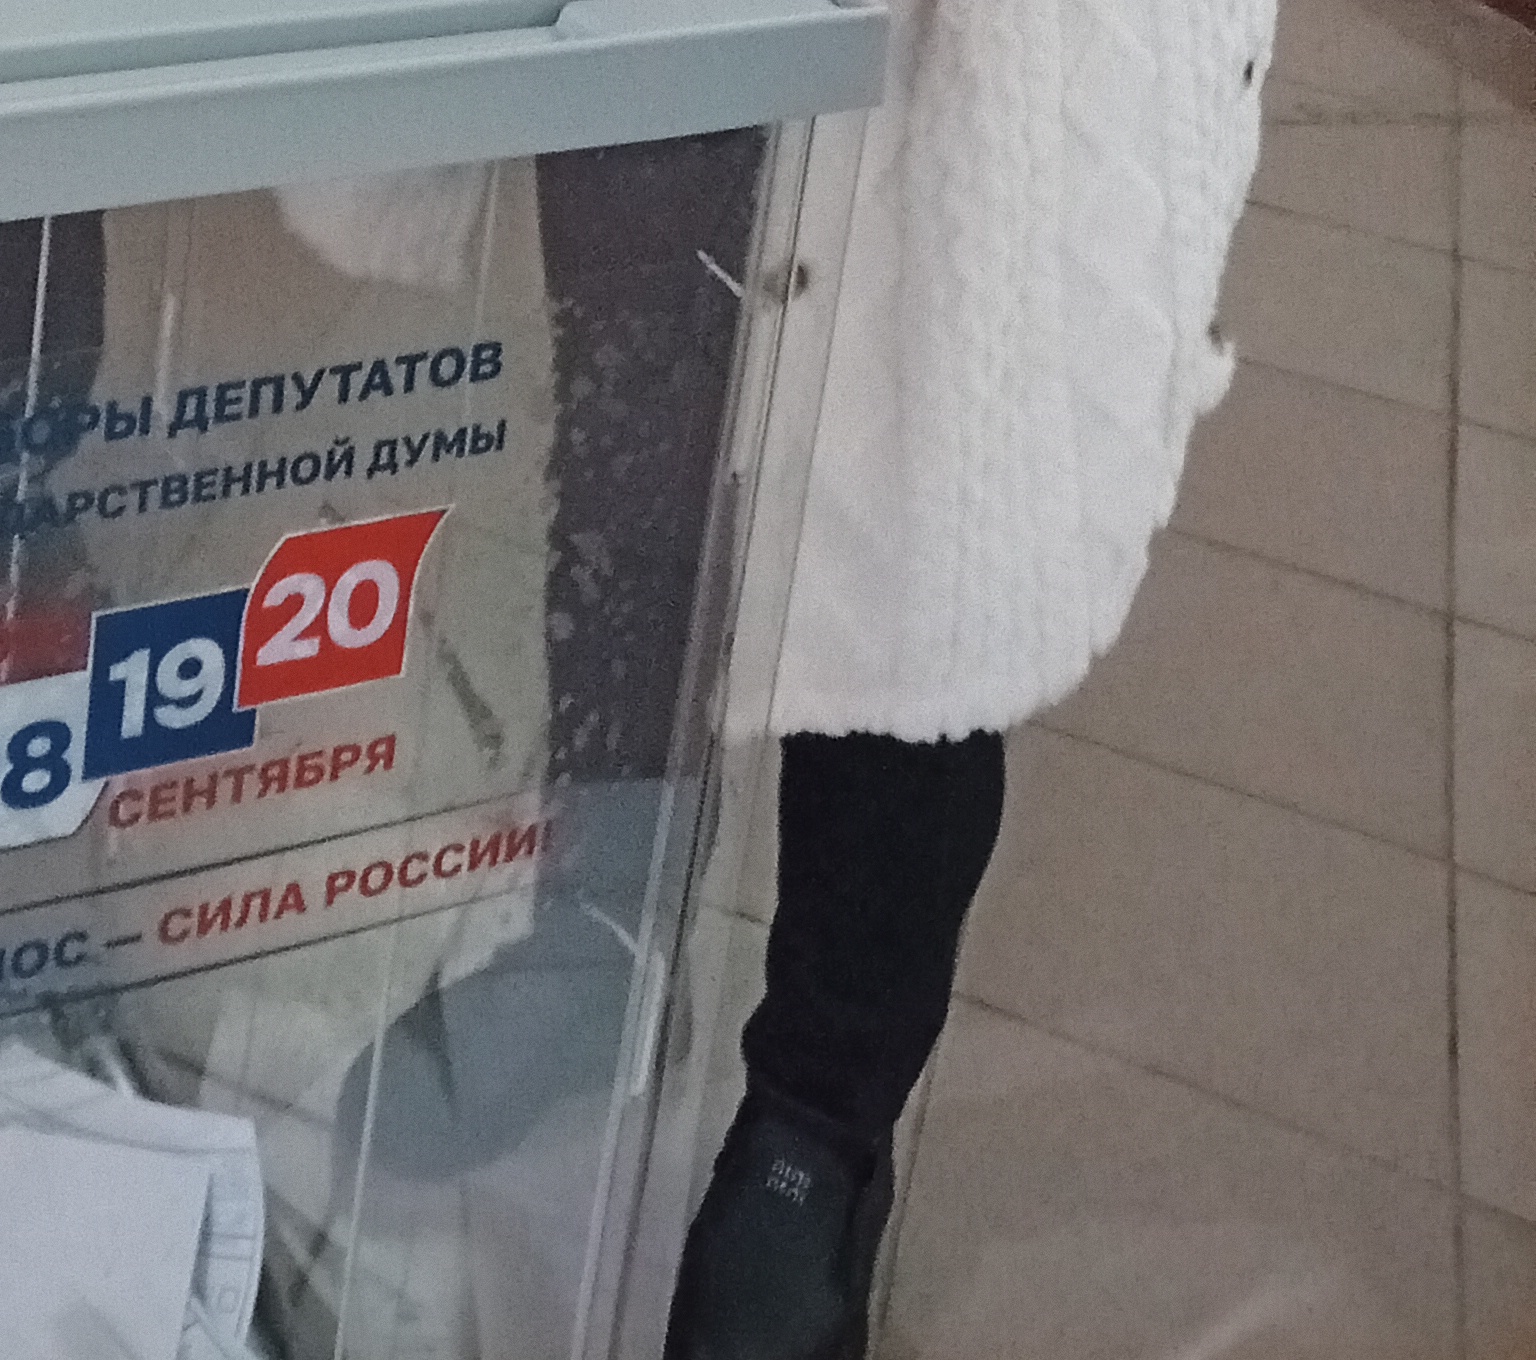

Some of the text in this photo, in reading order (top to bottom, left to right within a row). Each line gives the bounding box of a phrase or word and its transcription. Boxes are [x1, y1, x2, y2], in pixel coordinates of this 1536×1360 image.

[166, 340, 503, 439] ДЕПУТАТОВ
[365, 418, 507, 480] ДУМЫ
[108, 636, 227, 740] 19
[255, 558, 400, 668] 20
[107, 732, 397, 830] СЕНТЯБРЯ
[157, 880, 307, 946] СИЛА
